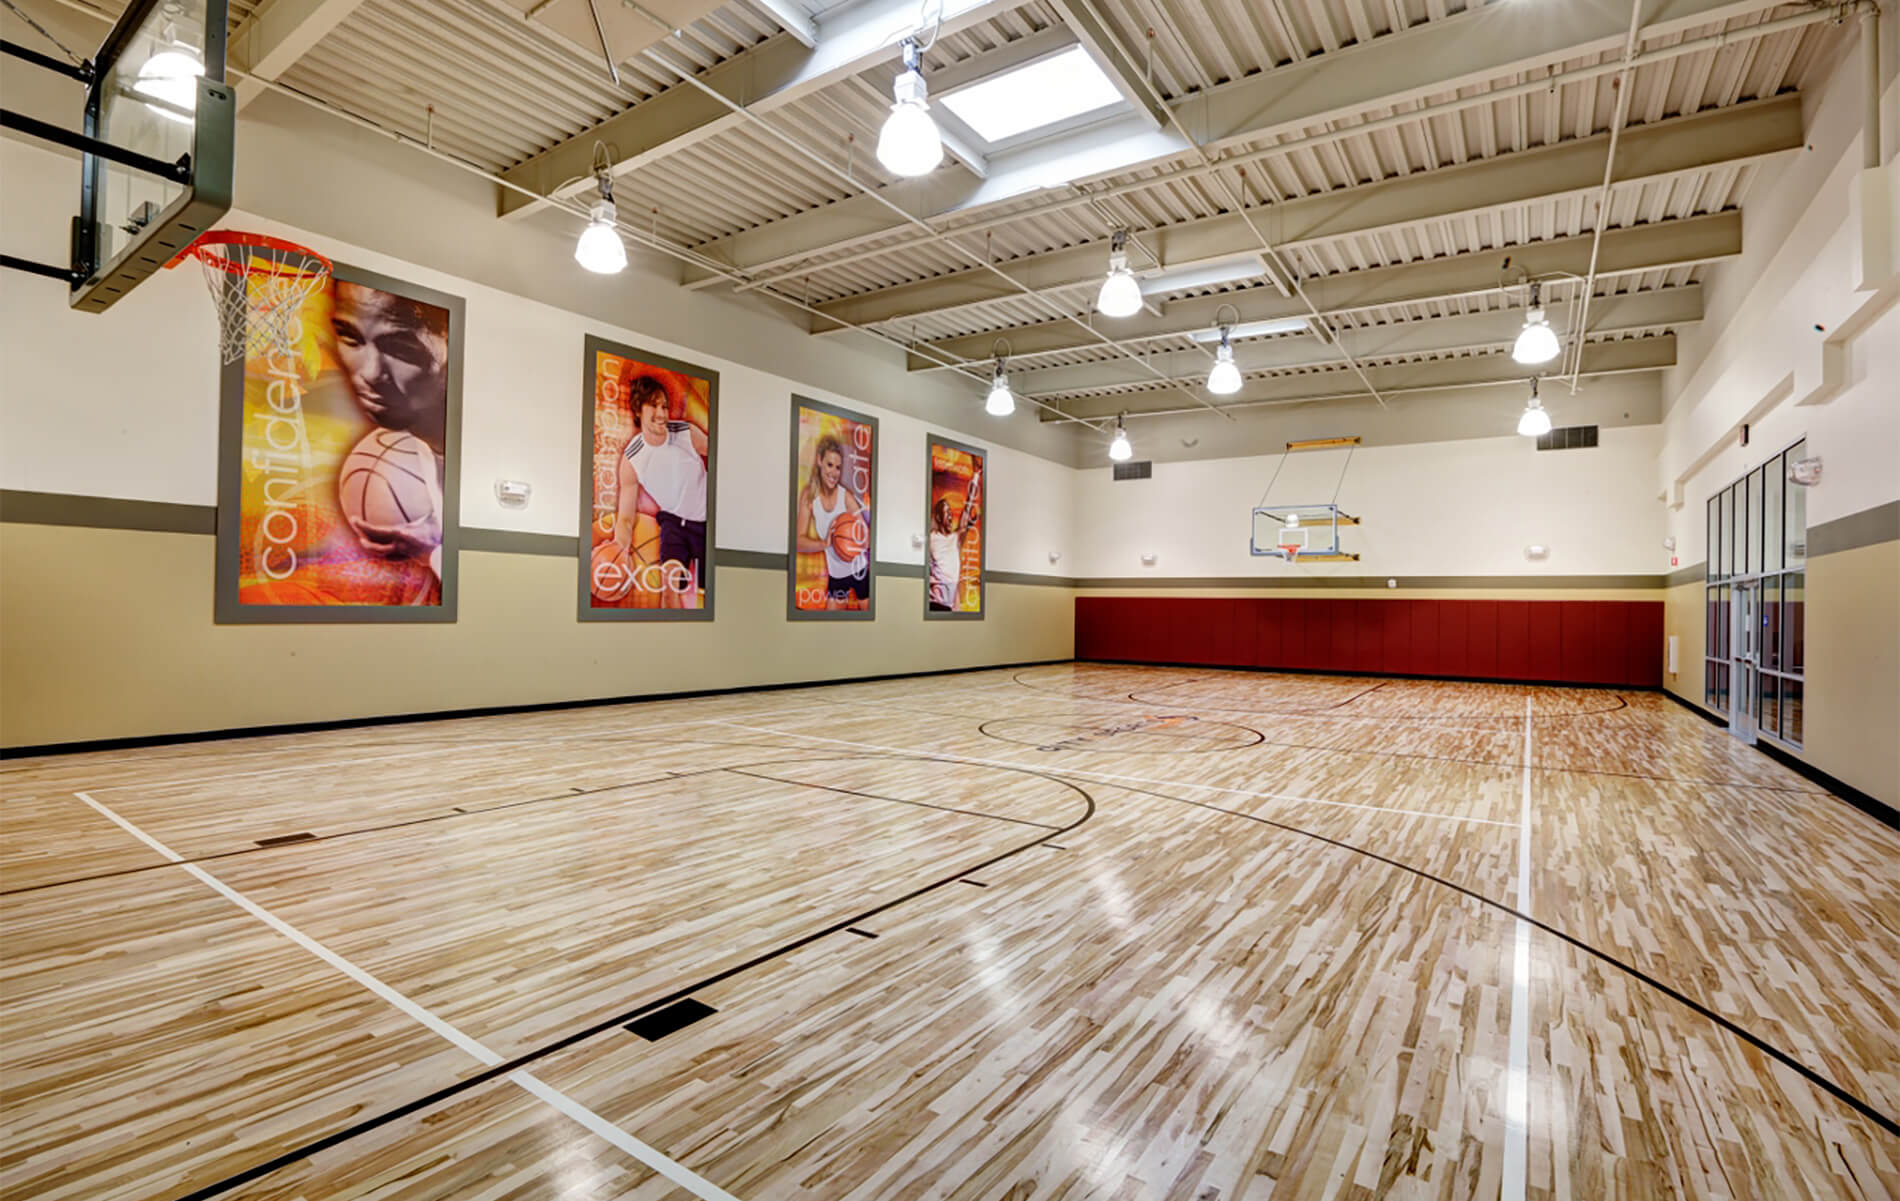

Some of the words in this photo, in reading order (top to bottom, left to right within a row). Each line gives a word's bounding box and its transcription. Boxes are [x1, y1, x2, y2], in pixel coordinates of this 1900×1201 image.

[593, 358, 620, 533] champion
[847, 424, 870, 580] elevate
[593, 558, 699, 592] excel
[799, 588, 850, 608] power
[962, 479, 980, 606] attitude
